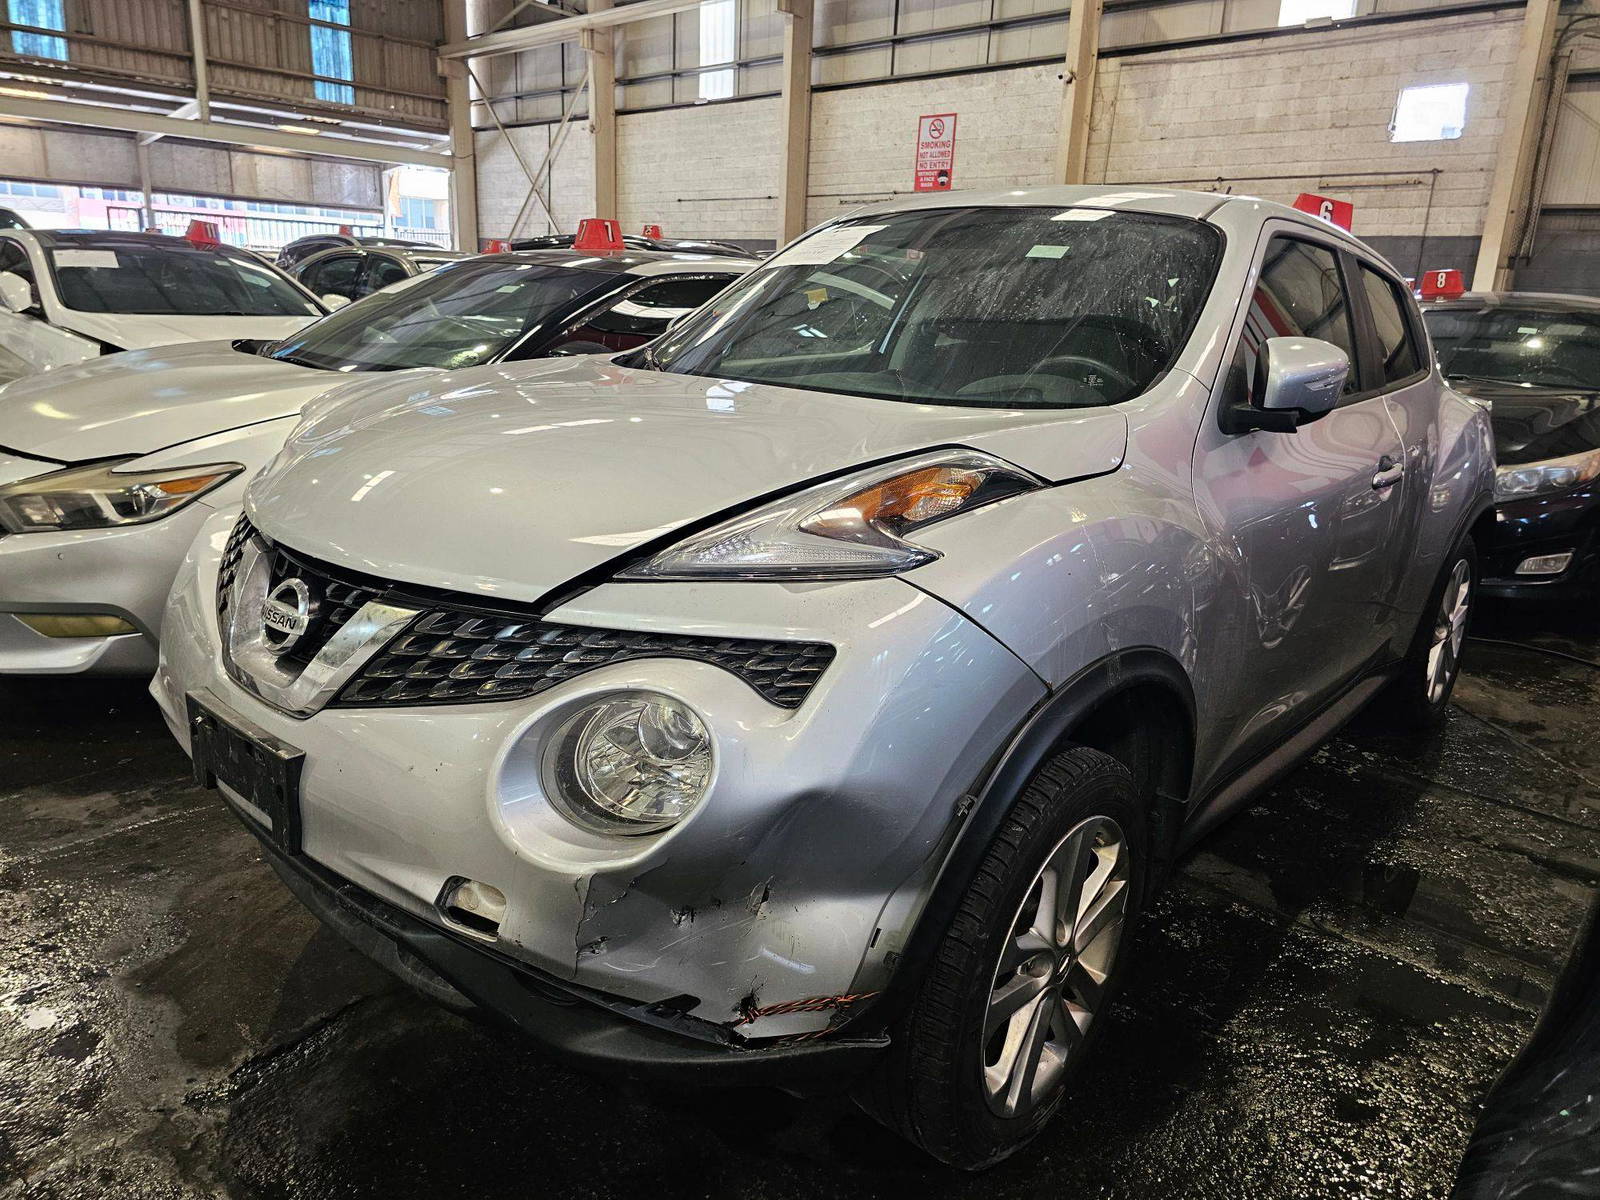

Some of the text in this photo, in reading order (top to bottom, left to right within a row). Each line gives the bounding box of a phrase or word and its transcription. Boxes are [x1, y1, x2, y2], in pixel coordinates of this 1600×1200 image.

[920, 140, 951, 150] SMOKING
[919, 150, 951, 159] NOT ALLOWED
[929, 160, 949, 169] ENTRY
[1320, 200, 1334, 222] 6
[604, 221, 613, 242] 1
[1436, 272, 1446, 289] 8
[261, 603, 297, 630] NISSAN
